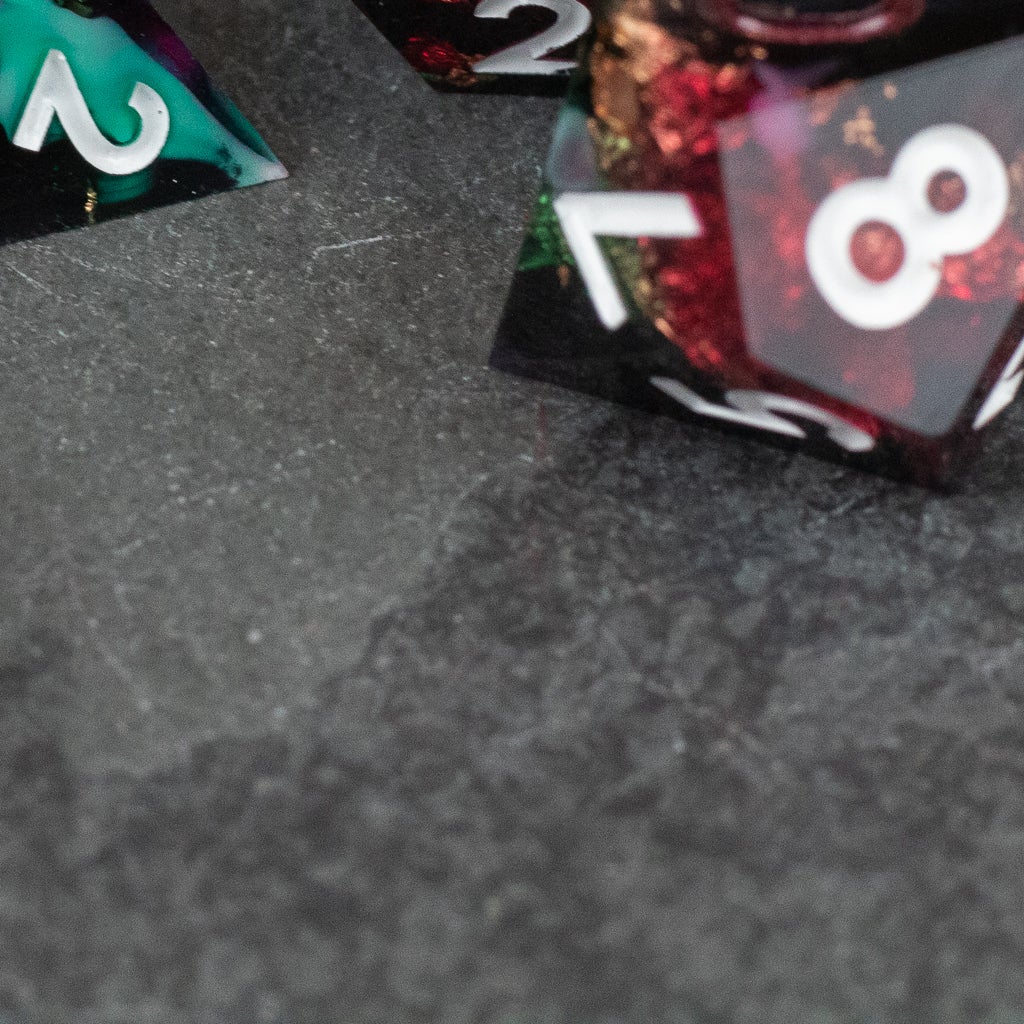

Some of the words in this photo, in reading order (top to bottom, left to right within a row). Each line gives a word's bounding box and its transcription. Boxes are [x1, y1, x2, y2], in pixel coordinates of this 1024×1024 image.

[12, 48, 171, 176] 2
[552, 189, 704, 331] 7
[804, 123, 1010, 330] 8
